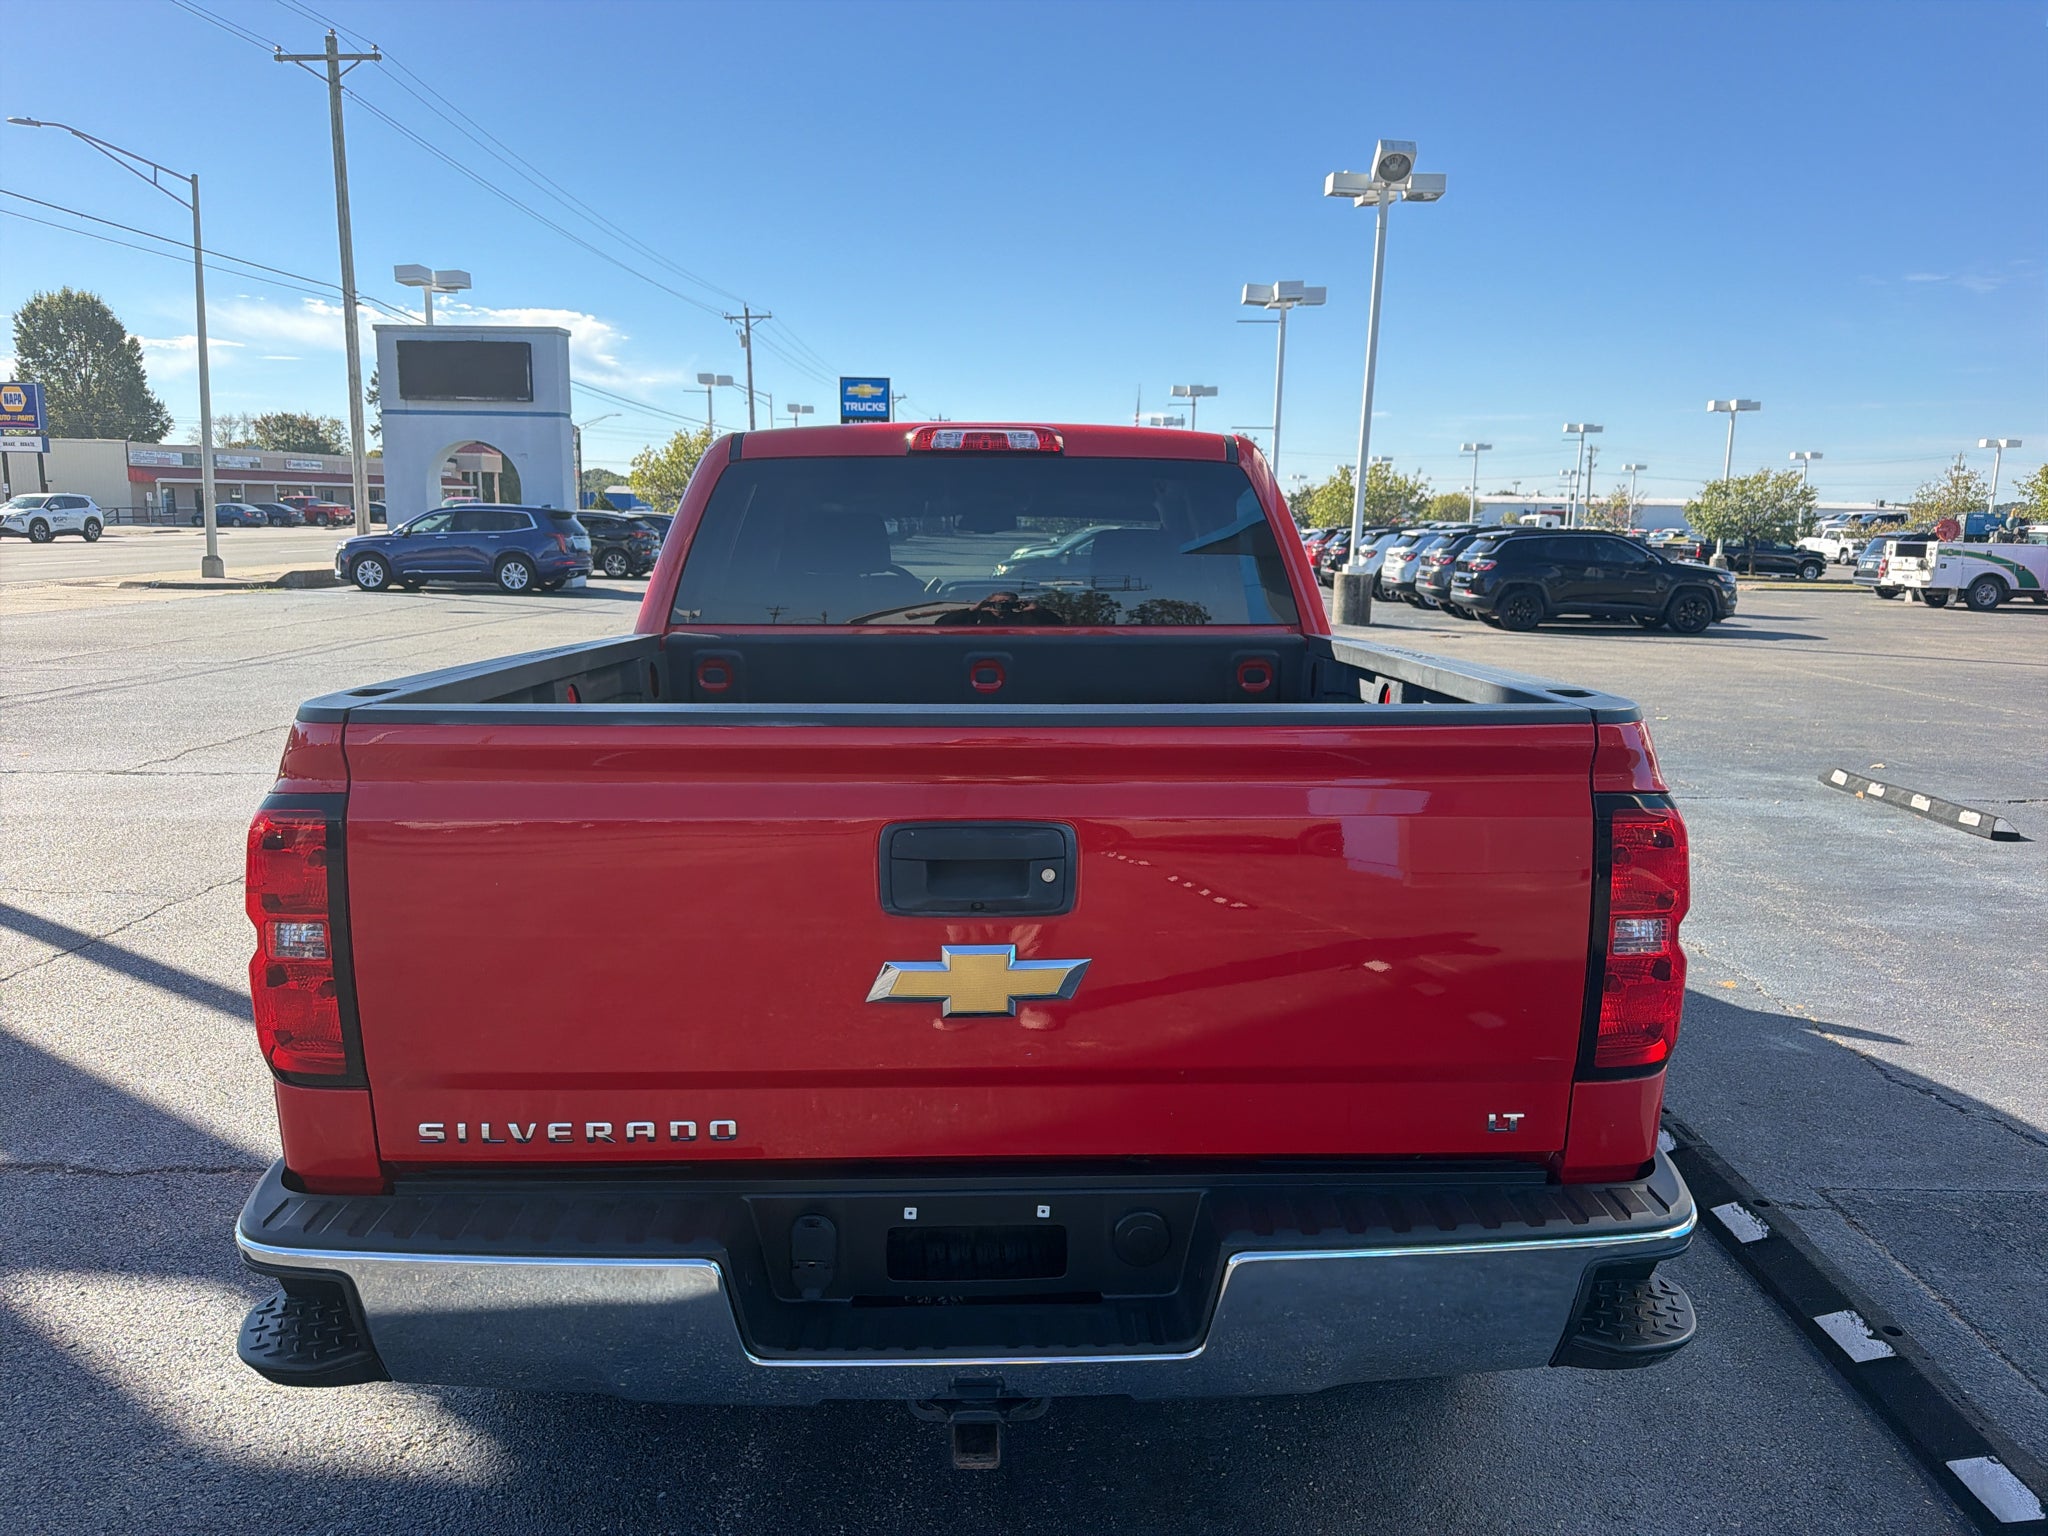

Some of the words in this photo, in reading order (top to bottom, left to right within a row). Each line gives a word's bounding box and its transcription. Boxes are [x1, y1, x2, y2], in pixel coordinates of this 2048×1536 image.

[4, 393, 22, 404] NAPA
[844, 402, 886, 411] TRUCKS
[1487, 1112, 1525, 1133] LT
[418, 1120, 738, 1144] SILVERADO
